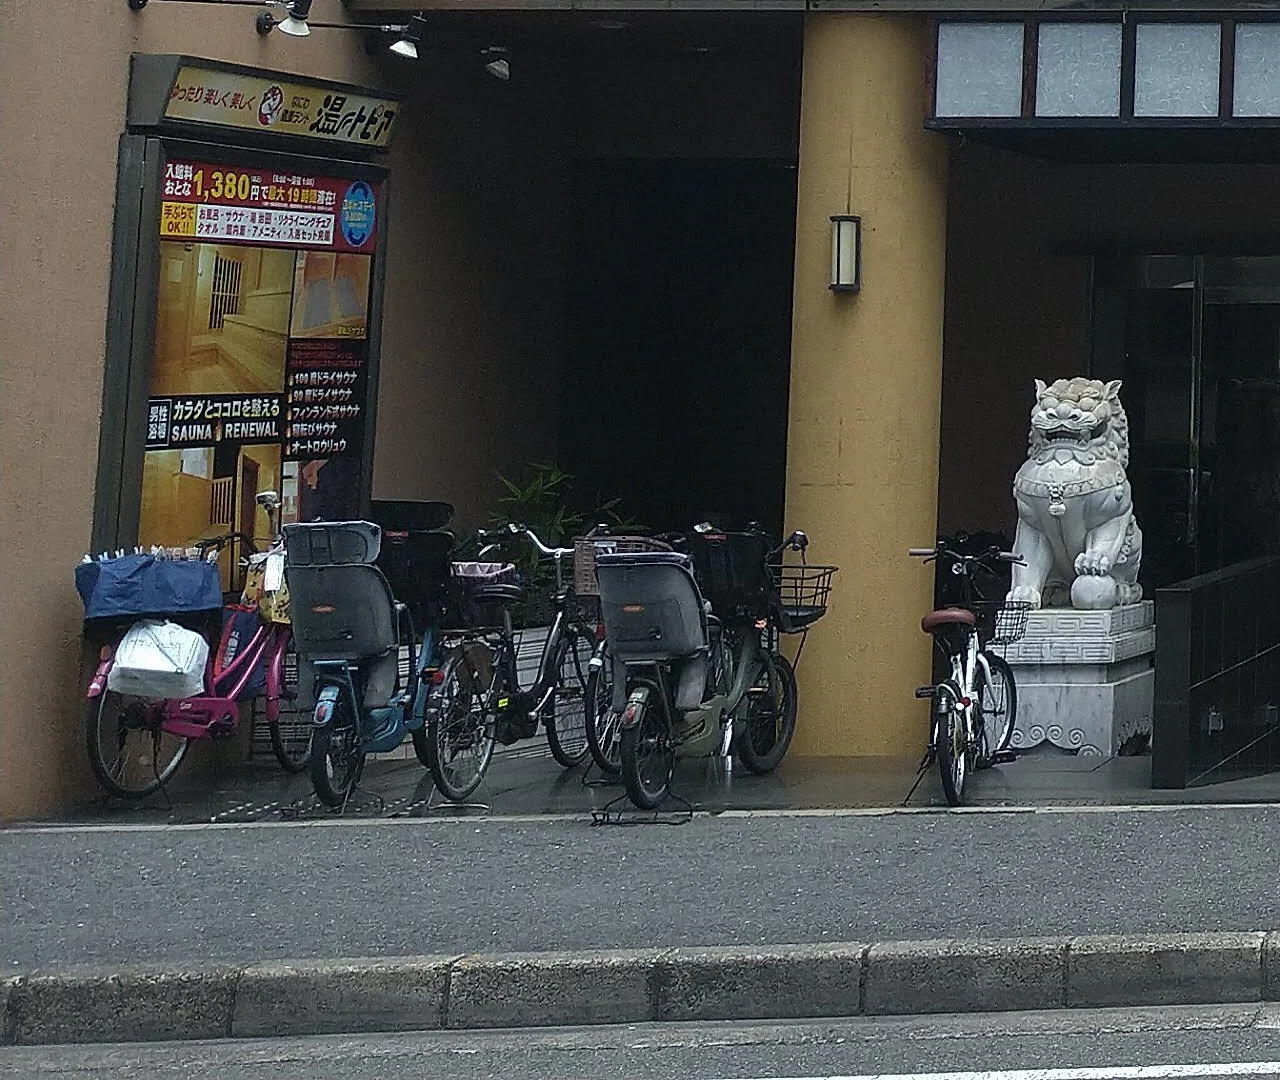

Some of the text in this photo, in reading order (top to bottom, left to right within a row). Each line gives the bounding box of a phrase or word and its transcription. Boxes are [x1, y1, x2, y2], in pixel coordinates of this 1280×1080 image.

[203, 88, 229, 108] 楽しく
[165, 163, 194, 180] 入館料
[164, 180, 192, 197] おとな
[172, 398, 281, 420] カラダとココロを整える
[171, 421, 279, 441] SAUNA RENEWAL
